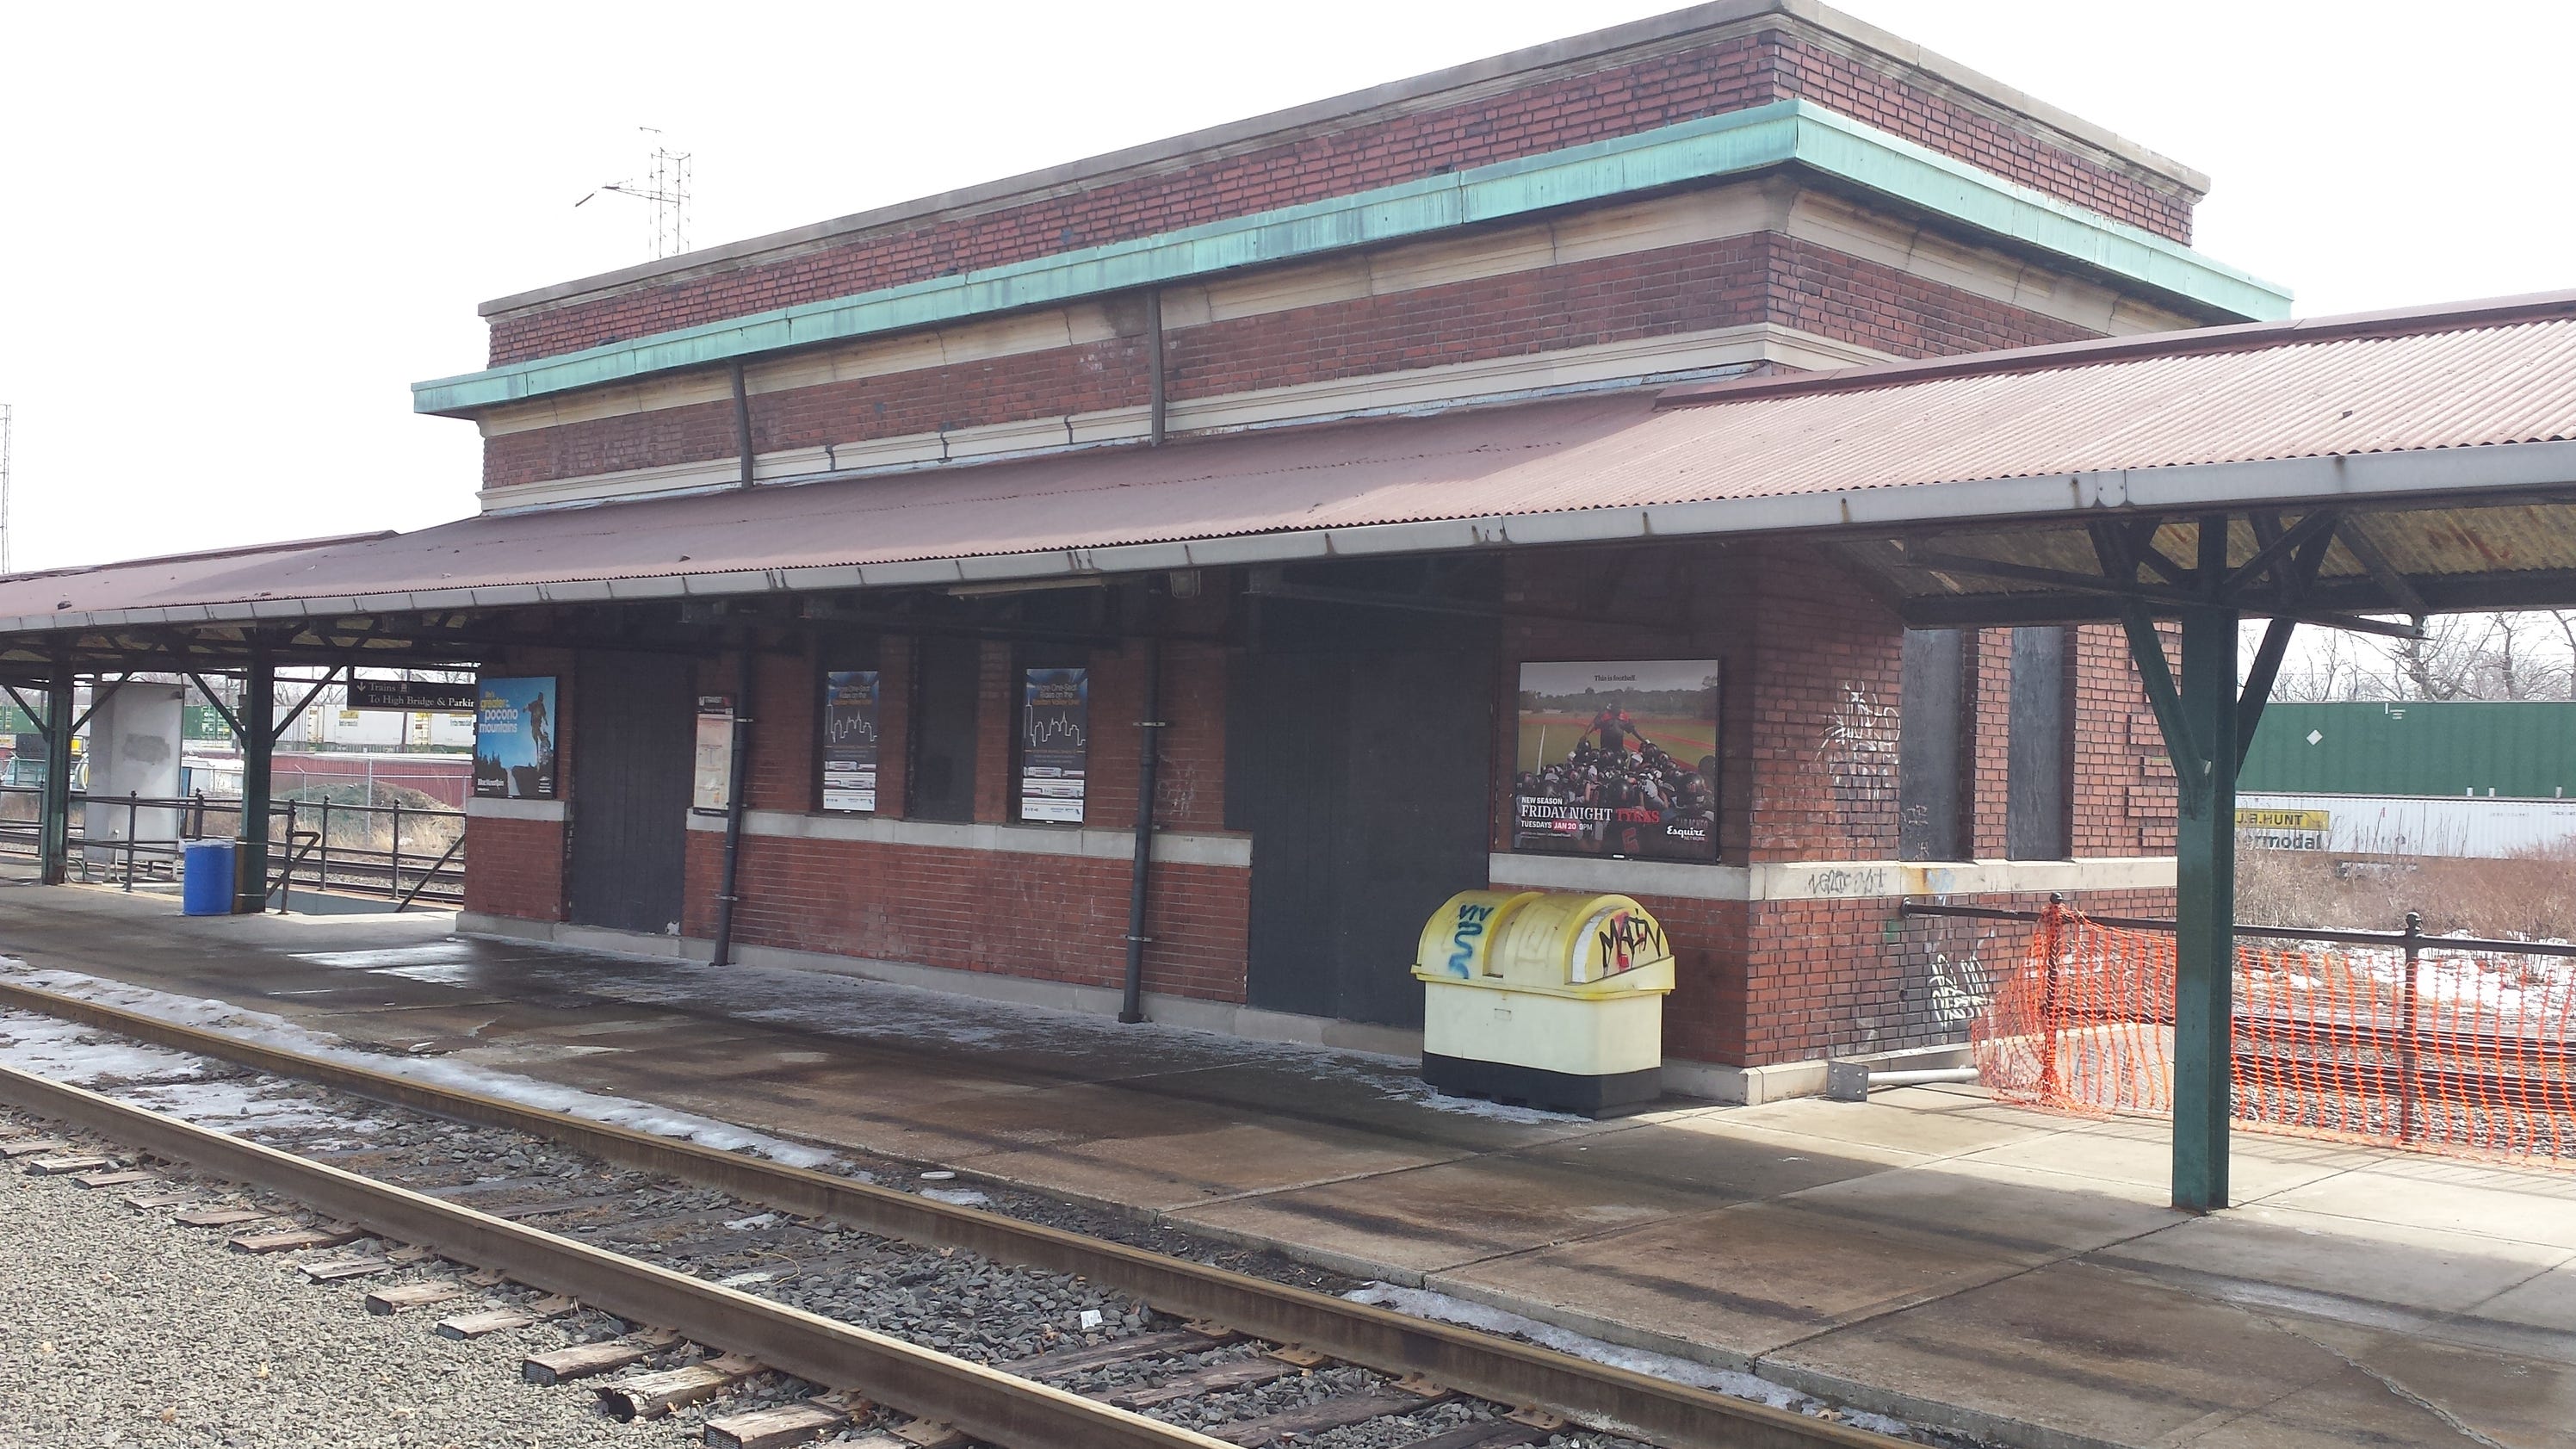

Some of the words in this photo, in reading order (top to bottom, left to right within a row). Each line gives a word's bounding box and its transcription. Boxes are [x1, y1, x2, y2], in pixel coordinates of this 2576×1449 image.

[368, 683, 396, 691] Trains
[368, 694, 381, 703] To
[382, 695, 405, 705] High
[406, 696, 435, 707] Bridge
[437, 697, 446, 706] &
[485, 709, 518, 723] pocono
[479, 721, 518, 734] mountains
[1520, 804, 1568, 819] FRIDAY
[1570, 807, 1613, 821] NIGHT
[1520, 820, 1552, 829] TUESDAYS
[1567, 822, 1577, 831] 20
[1666, 825, 1706, 839] Esquire
[2244, 833, 2322, 850] ermodal
